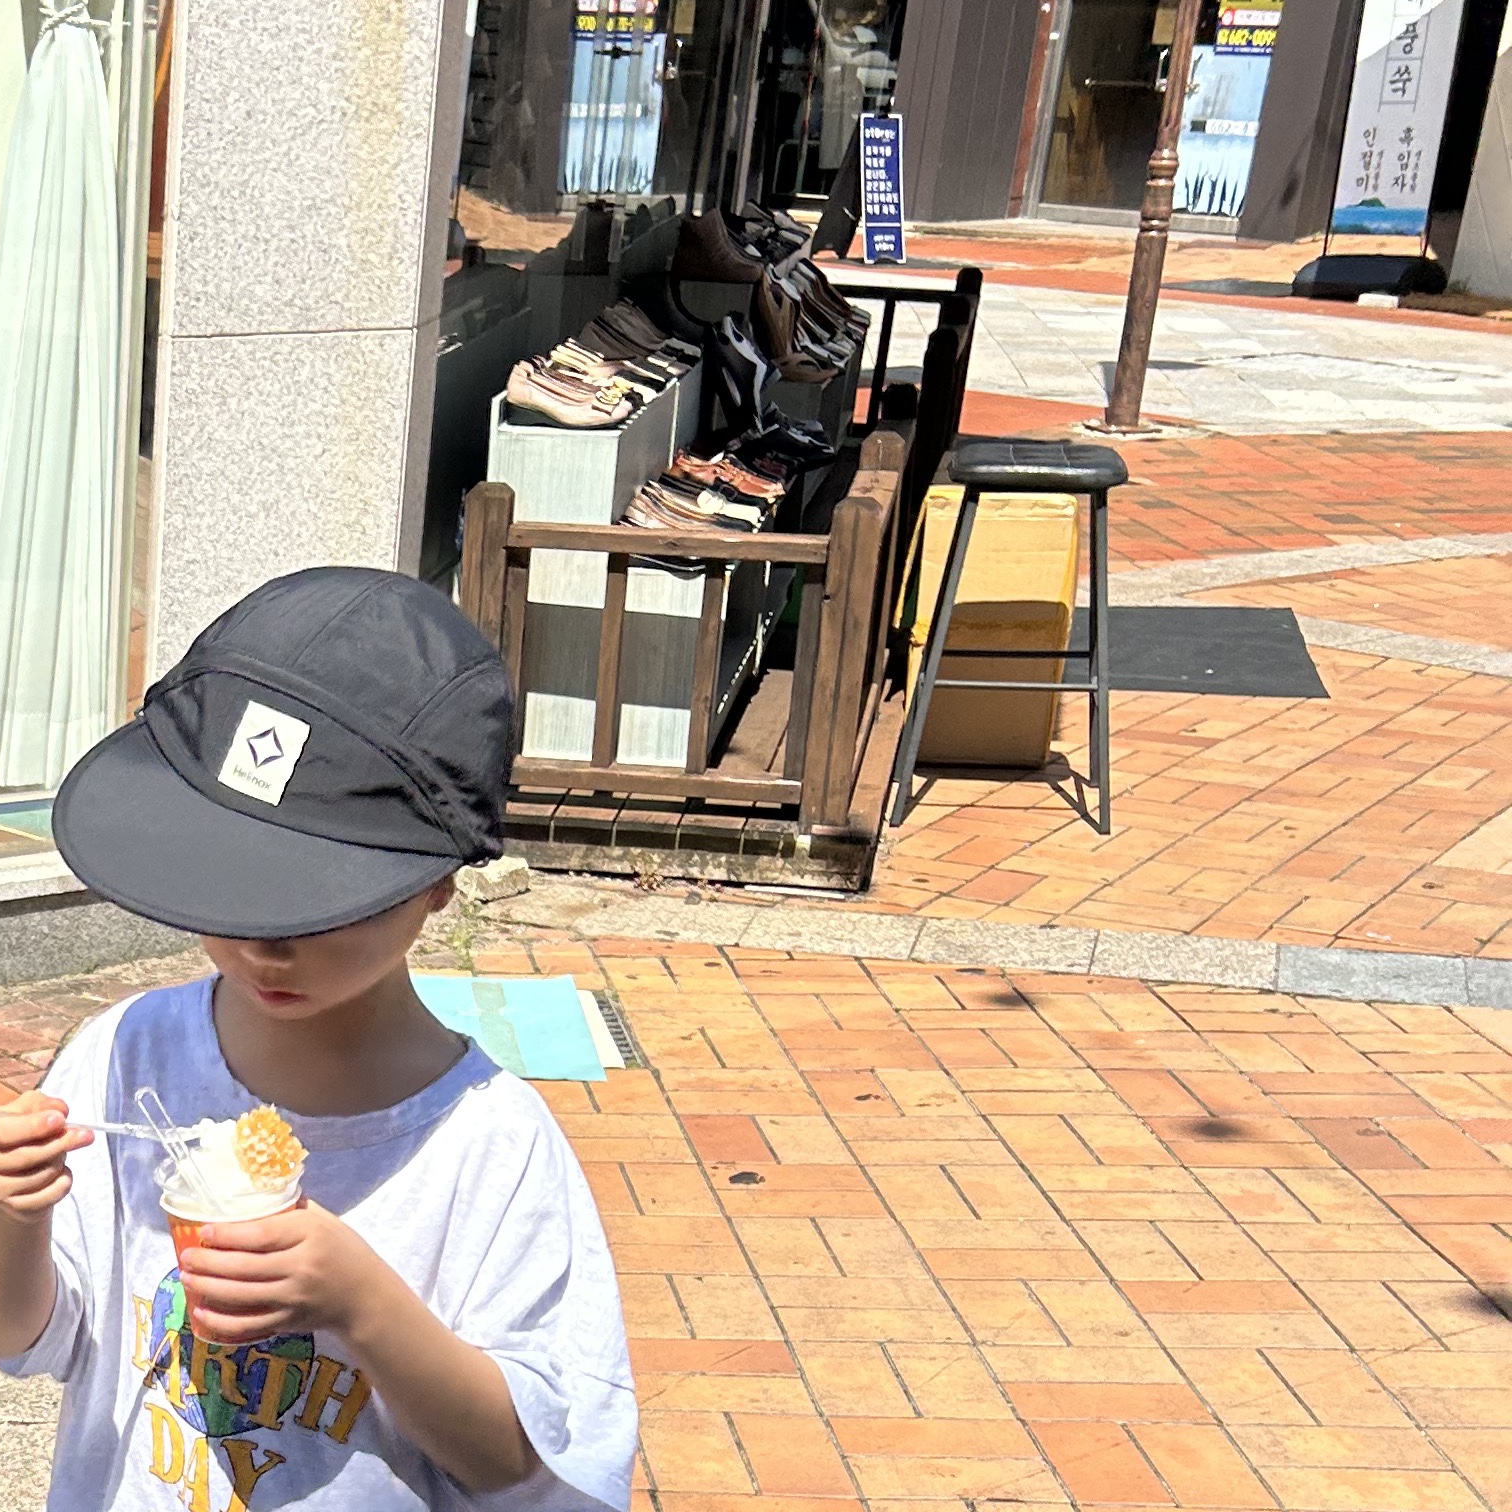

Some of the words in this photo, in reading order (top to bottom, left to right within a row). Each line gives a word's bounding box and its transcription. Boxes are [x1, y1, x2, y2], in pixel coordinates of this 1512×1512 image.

[1392, 126, 1414, 193] 흑임자
[233, 764, 272, 789] Helinox
[132, 1295, 371, 1444] EARTH
